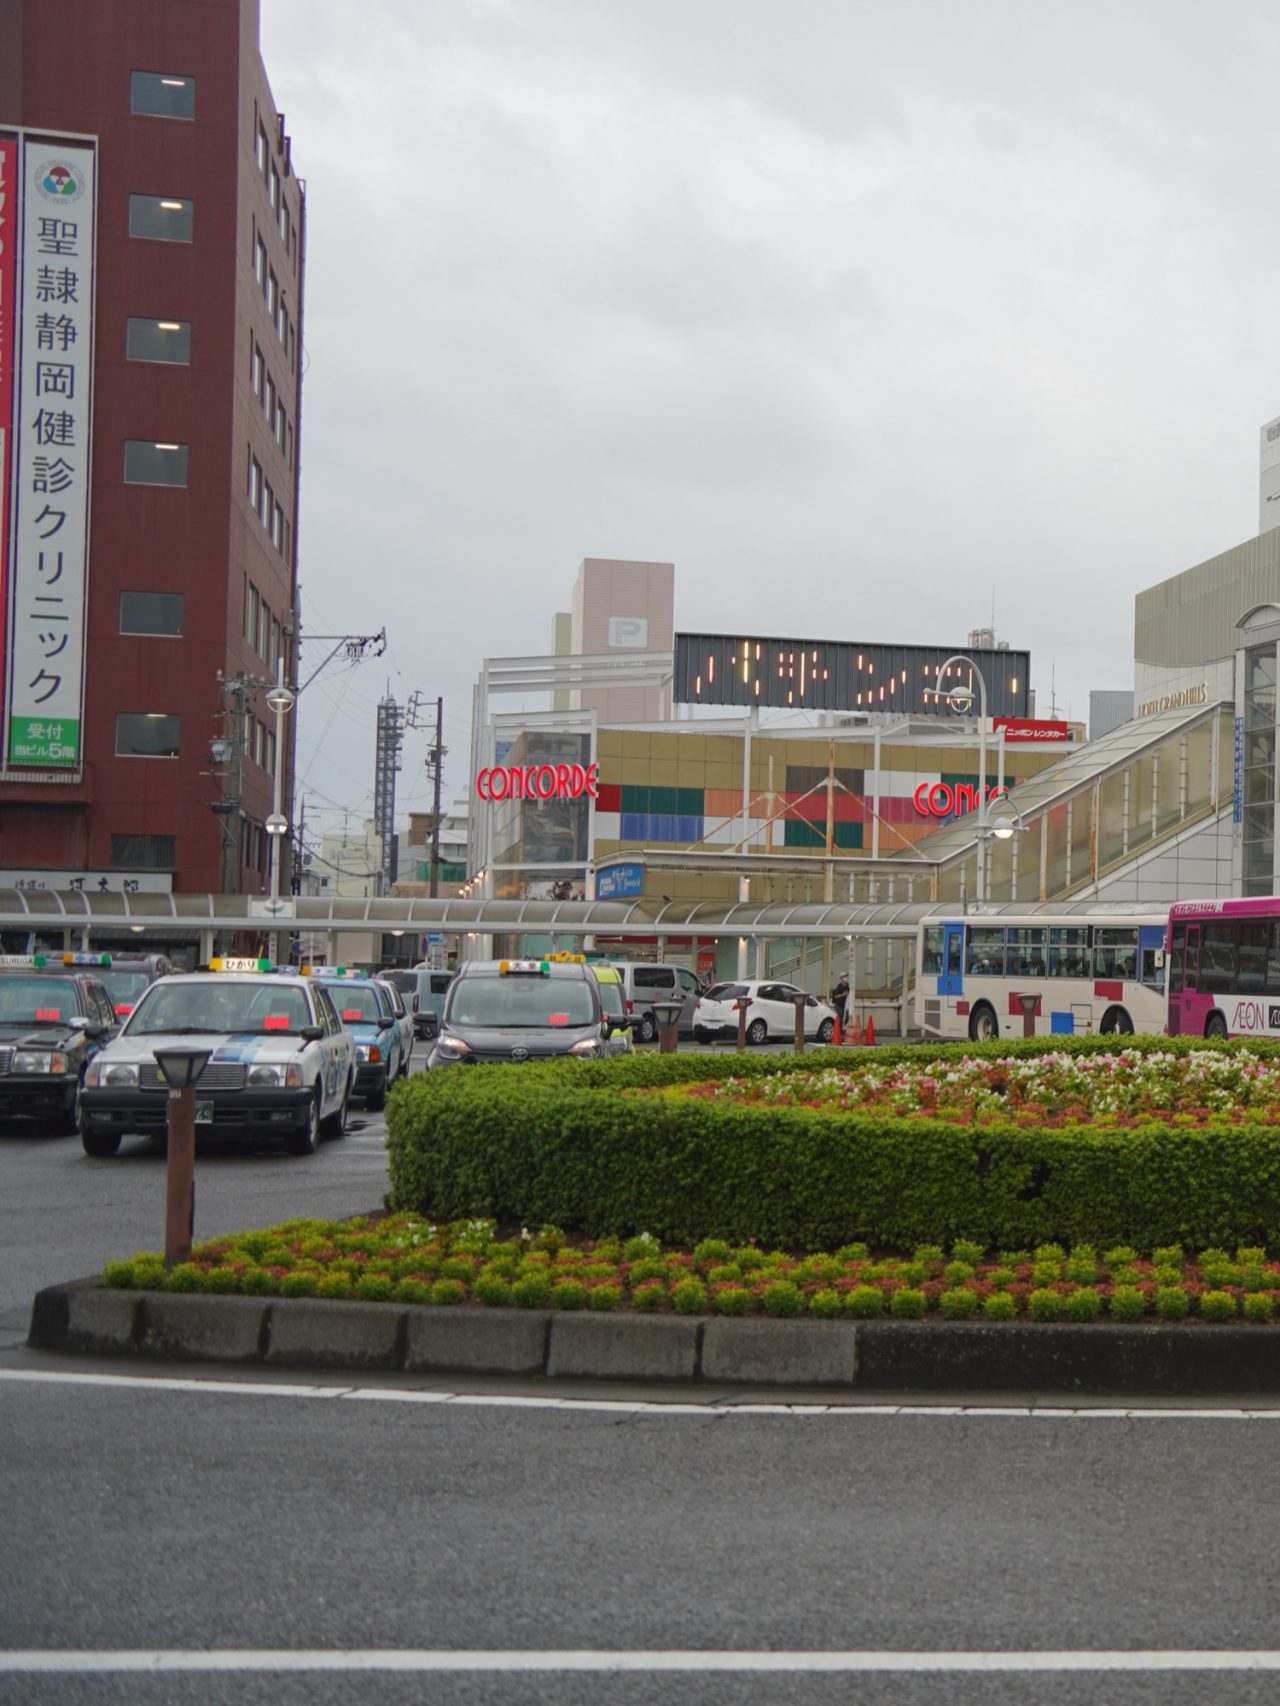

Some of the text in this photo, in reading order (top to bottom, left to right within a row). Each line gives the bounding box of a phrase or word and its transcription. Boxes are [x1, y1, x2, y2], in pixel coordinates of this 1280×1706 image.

[29, 216, 80, 704] 聖隷静岡健診クリニック
[615, 620, 641, 645] P
[27, 722, 64, 740] 受付
[476, 763, 599, 800] CONCORDE
[225, 960, 256, 970] ひかり
